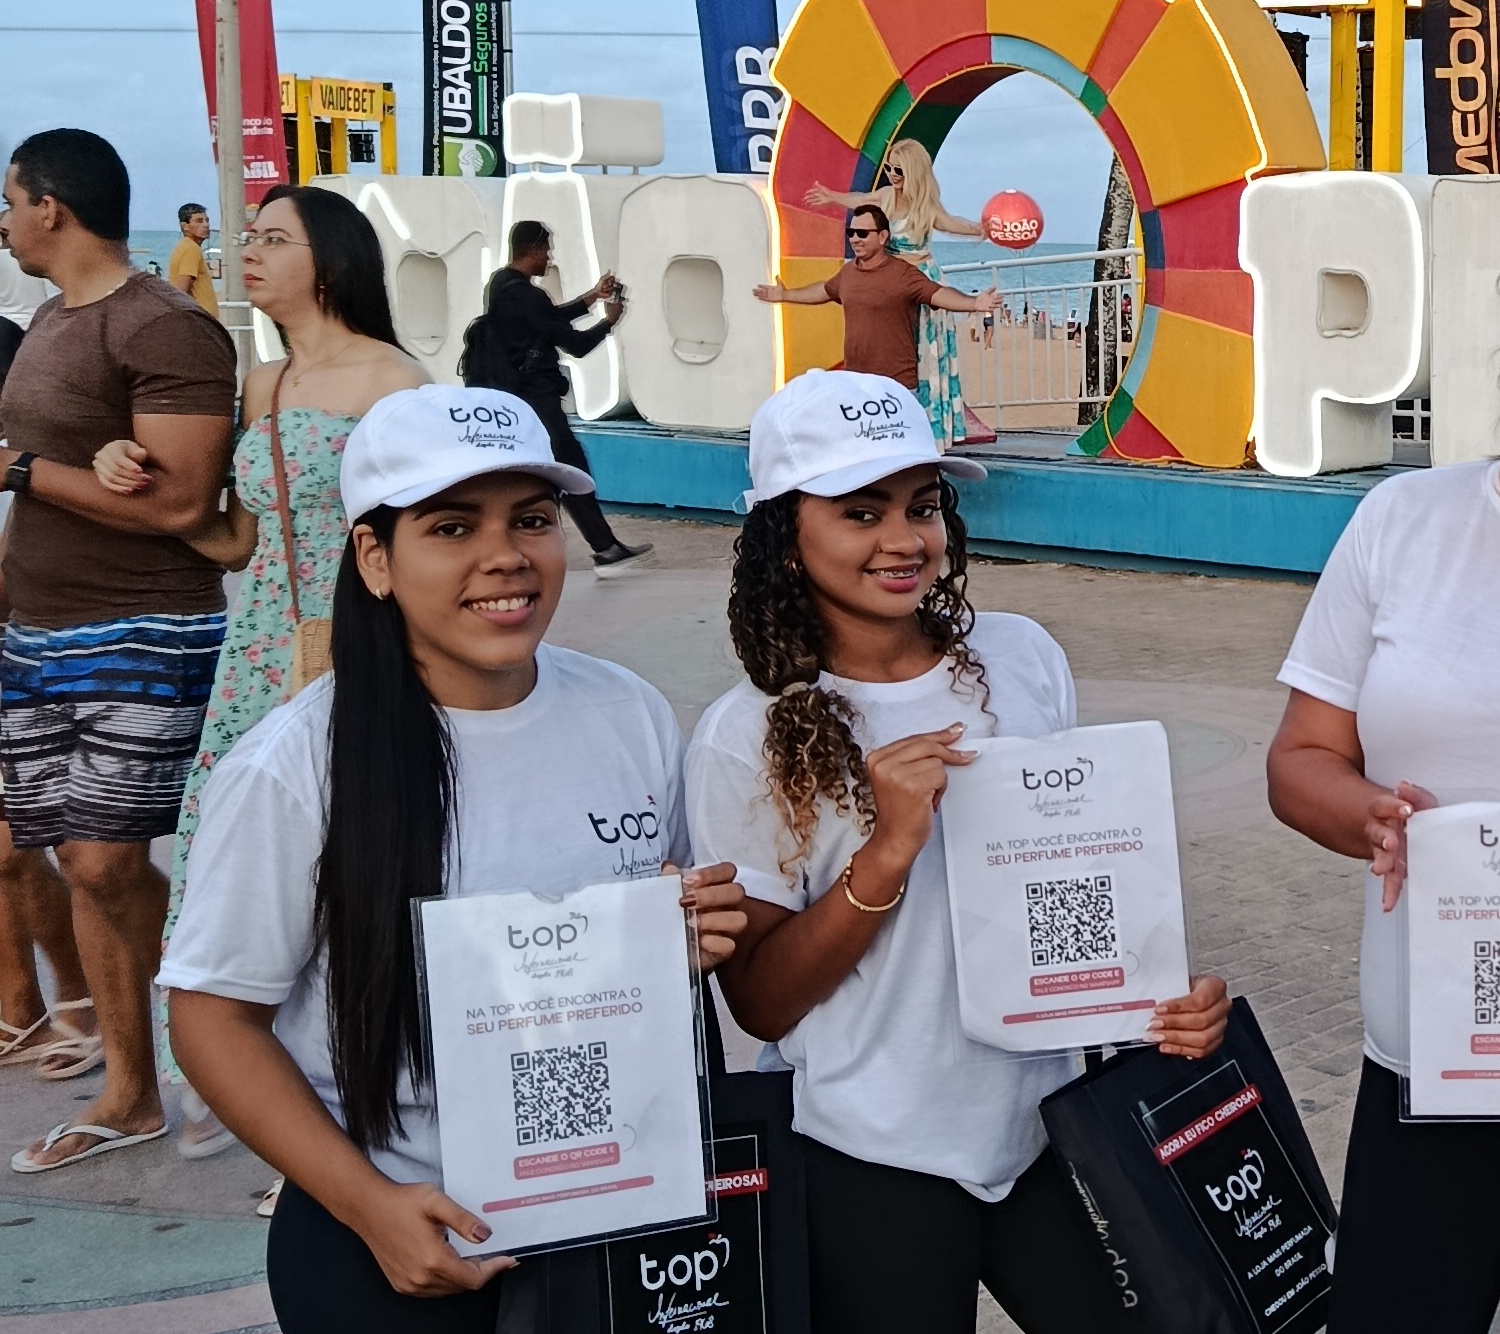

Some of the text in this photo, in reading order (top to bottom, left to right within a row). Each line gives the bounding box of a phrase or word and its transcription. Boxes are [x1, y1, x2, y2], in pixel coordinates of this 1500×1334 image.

[473, 2, 492, 74] Seguros
[440, 0, 473, 135] UBALDO
[319, 84, 376, 115] VAIDEBET
[990, 230, 1037, 241] PESSOA
[1003, 218, 1039, 233] JOÃO
[449, 406, 512, 429] top
[839, 398, 898, 421] top
[1022, 768, 1084, 792] top
[587, 811, 659, 847] top
[986, 827, 1142, 852] NA TOP VOCÊ ENCONTRA O
[987, 840, 1143, 867] SEU PERFUME PREFERIDO
[1438, 896, 1455, 906] NA
[1459, 895, 1481, 906] TOP
[1438, 909, 1462, 920] SEU
[508, 923, 578, 950] top
[466, 987, 642, 1020] NA TOP VOCÊ ENCONTRA O
[466, 1001, 643, 1036] SEU PERFUME PREFERIDO
[1158, 1088, 1258, 1160] AGORA EU FICO CHEIROSA!
[1205, 1164, 1262, 1212] top
[1247, 1271, 1255, 1280] A
[1252, 1259, 1269, 1275] LOJA
[1266, 1248, 1282, 1264] MAIS
[1280, 1225, 1313, 1253] PERFUMADA
[1274, 1252, 1304, 1277] DO BRASIL
[639, 1249, 719, 1291] top
[1308, 1263, 1327, 1281] PESSO
